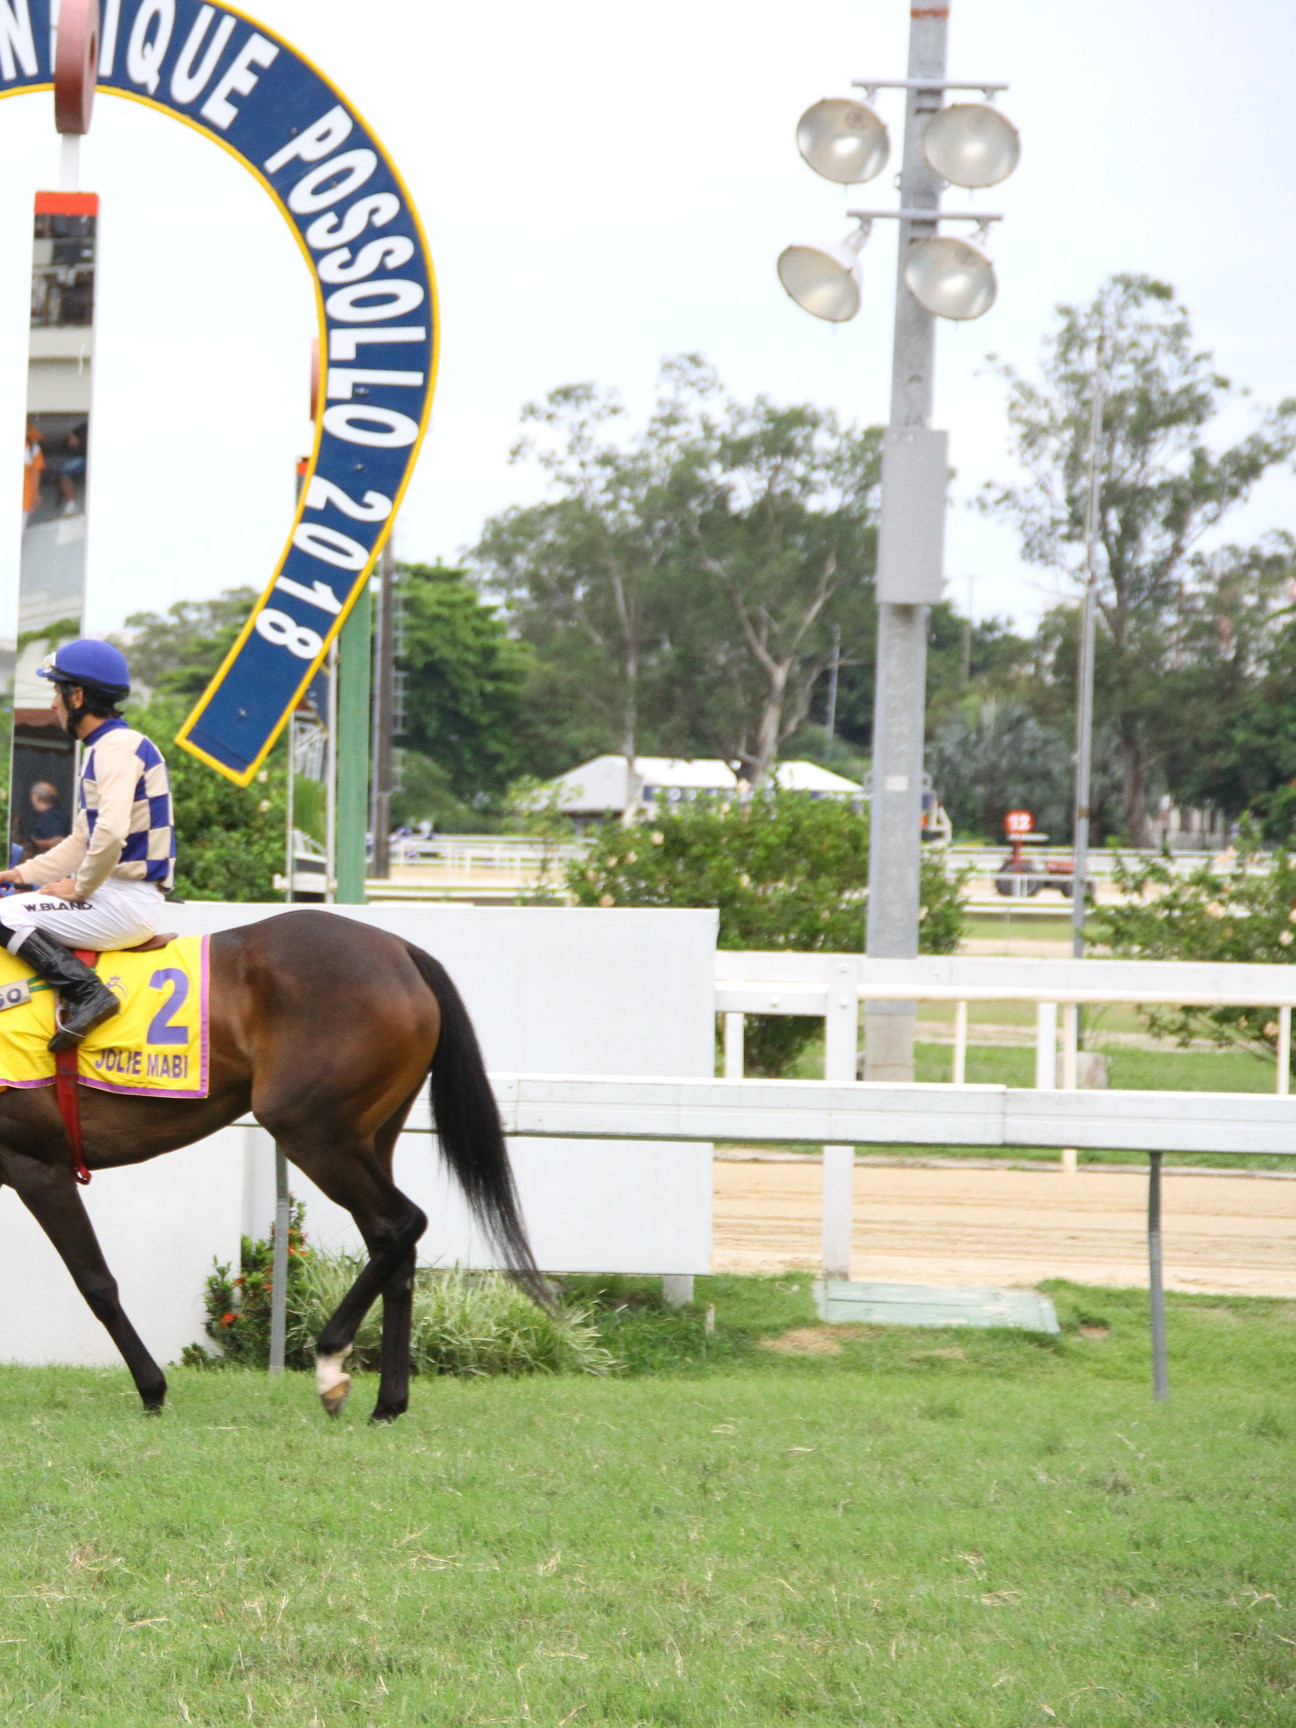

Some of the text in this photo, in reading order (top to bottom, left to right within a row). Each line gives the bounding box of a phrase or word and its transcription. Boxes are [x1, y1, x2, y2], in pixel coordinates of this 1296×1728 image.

[264, 105, 427, 448] POSSOLLO
[254, 474, 393, 660] 2018
[1007, 814, 1031, 831] 12
[147, 968, 189, 1044] 2
[94, 1049, 188, 1078] JOLIE MABI
